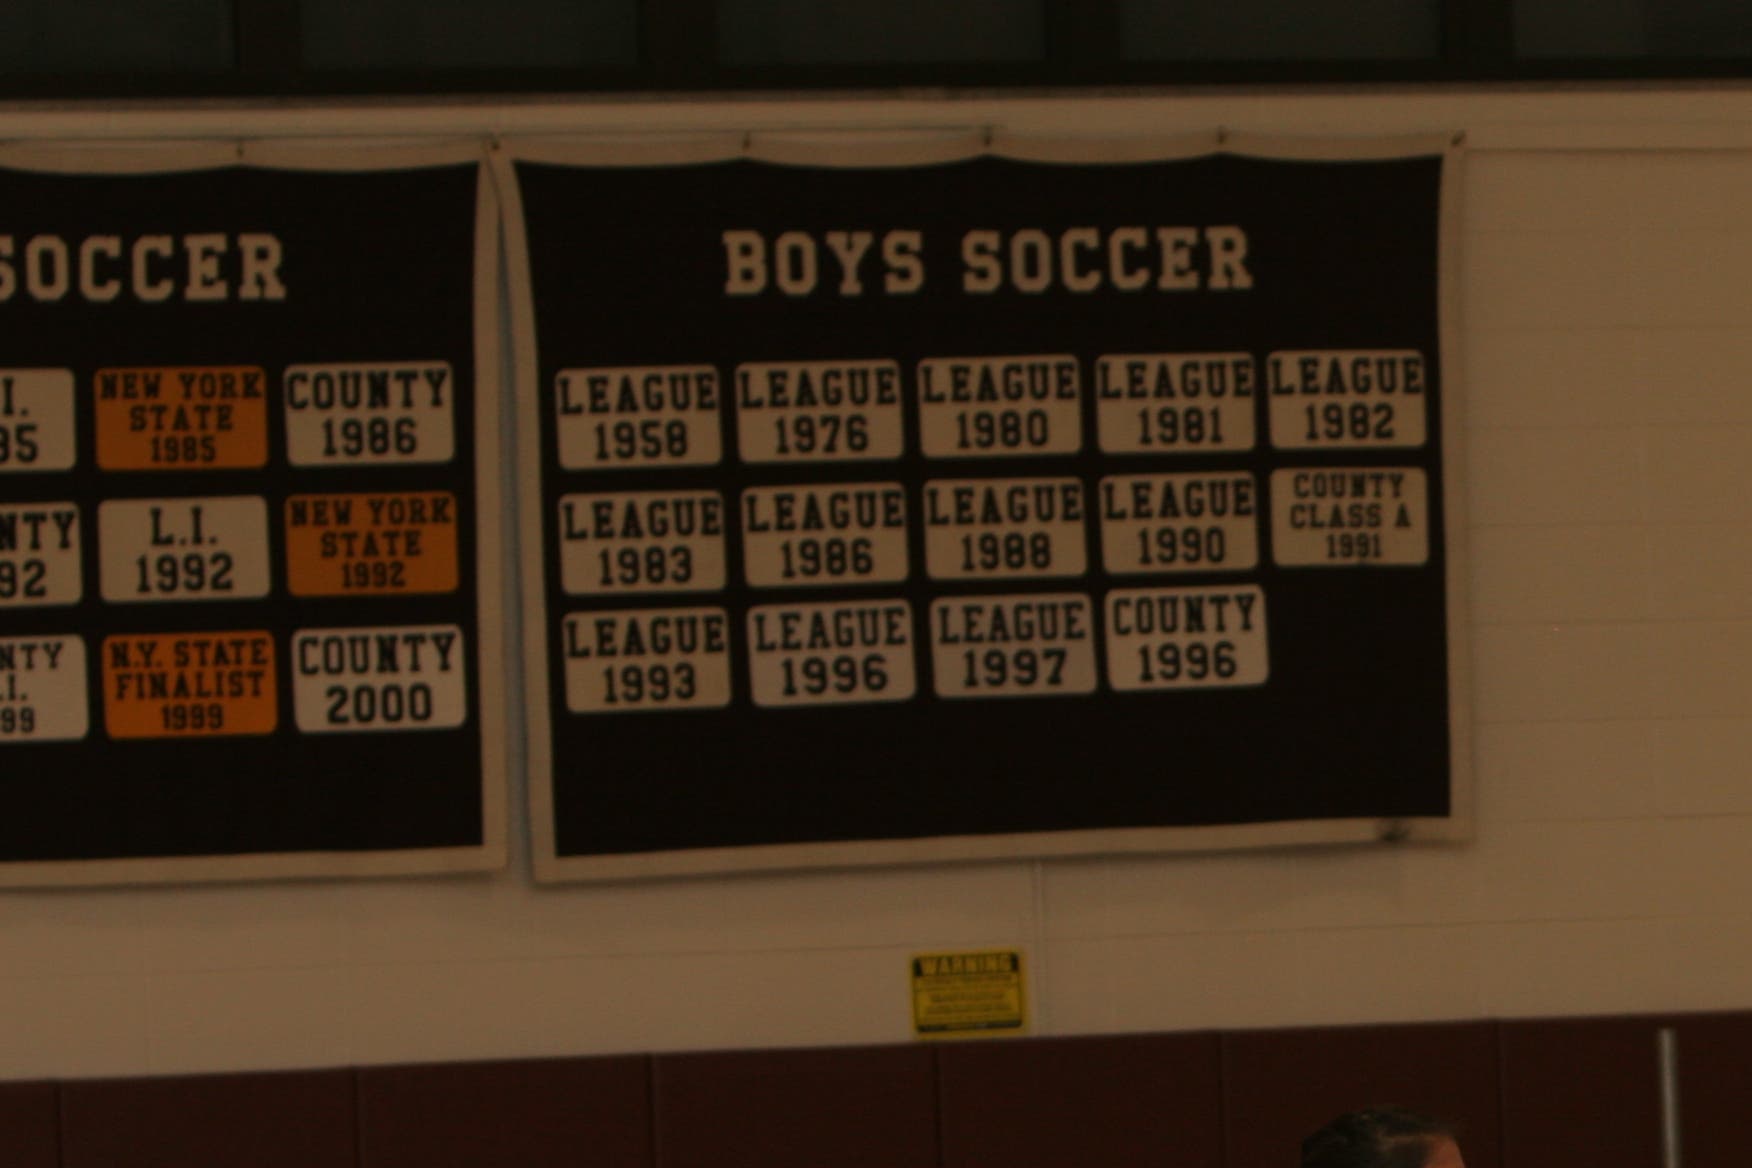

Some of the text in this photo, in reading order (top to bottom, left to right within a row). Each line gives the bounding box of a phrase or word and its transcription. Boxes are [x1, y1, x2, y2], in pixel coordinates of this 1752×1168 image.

[722, 225, 1254, 297] BOYS SOCCER
[101, 371, 263, 399] NEW YORK
[287, 370, 448, 410] COUNTY
[559, 373, 717, 414] LEAGUE
[740, 367, 897, 408] LEAGUE
[922, 362, 1076, 402] LEAGUE
[1101, 360, 1253, 399] LEAGUE
[1272, 357, 1423, 395] LEAGUE
[129, 405, 233, 431] STATE
[322, 418, 417, 456] 1986
[776, 414, 868, 453] 1976
[957, 409, 1048, 449] 1980
[1138, 407, 1223, 445] 1981
[1305, 402, 1394, 440] 1982
[150, 436, 216, 463] 1985
[596, 419, 687, 460] 1958
[927, 484, 1082, 525] LEAGUE
[1104, 479, 1253, 520] LEAGUE
[1294, 472, 1404, 498] COUNTY
[150, 507, 217, 546] L.I.
[291, 497, 450, 526] NEW YORK
[563, 499, 721, 540] LEAGUE
[745, 490, 904, 532] LEAGUE
[1290, 504, 1411, 529] CLASS A
[321, 530, 421, 558] STATE
[781, 537, 873, 577] 1986
[962, 532, 1051, 571] 1988
[1138, 526, 1225, 565] 1990
[1326, 533, 1382, 558] 1991
[136, 553, 233, 593] 1992
[342, 562, 406, 588] 1992
[600, 545, 691, 586] 1983
[754, 608, 906, 652] LEAGUE
[938, 602, 1086, 645] LEAGUE
[1113, 594, 1257, 635] COUNTY
[174, 638, 267, 667] STATE
[300, 633, 455, 675] COUNTY
[567, 615, 724, 658] LEAGUE
[782, 654, 888, 696] 1996
[965, 648, 1067, 687] 1997
[1138, 642, 1237, 683] 1996
[116, 670, 264, 700] FINALIST
[604, 662, 695, 703] 1993
[161, 704, 224, 730] 1999
[327, 685, 431, 723] 2000
